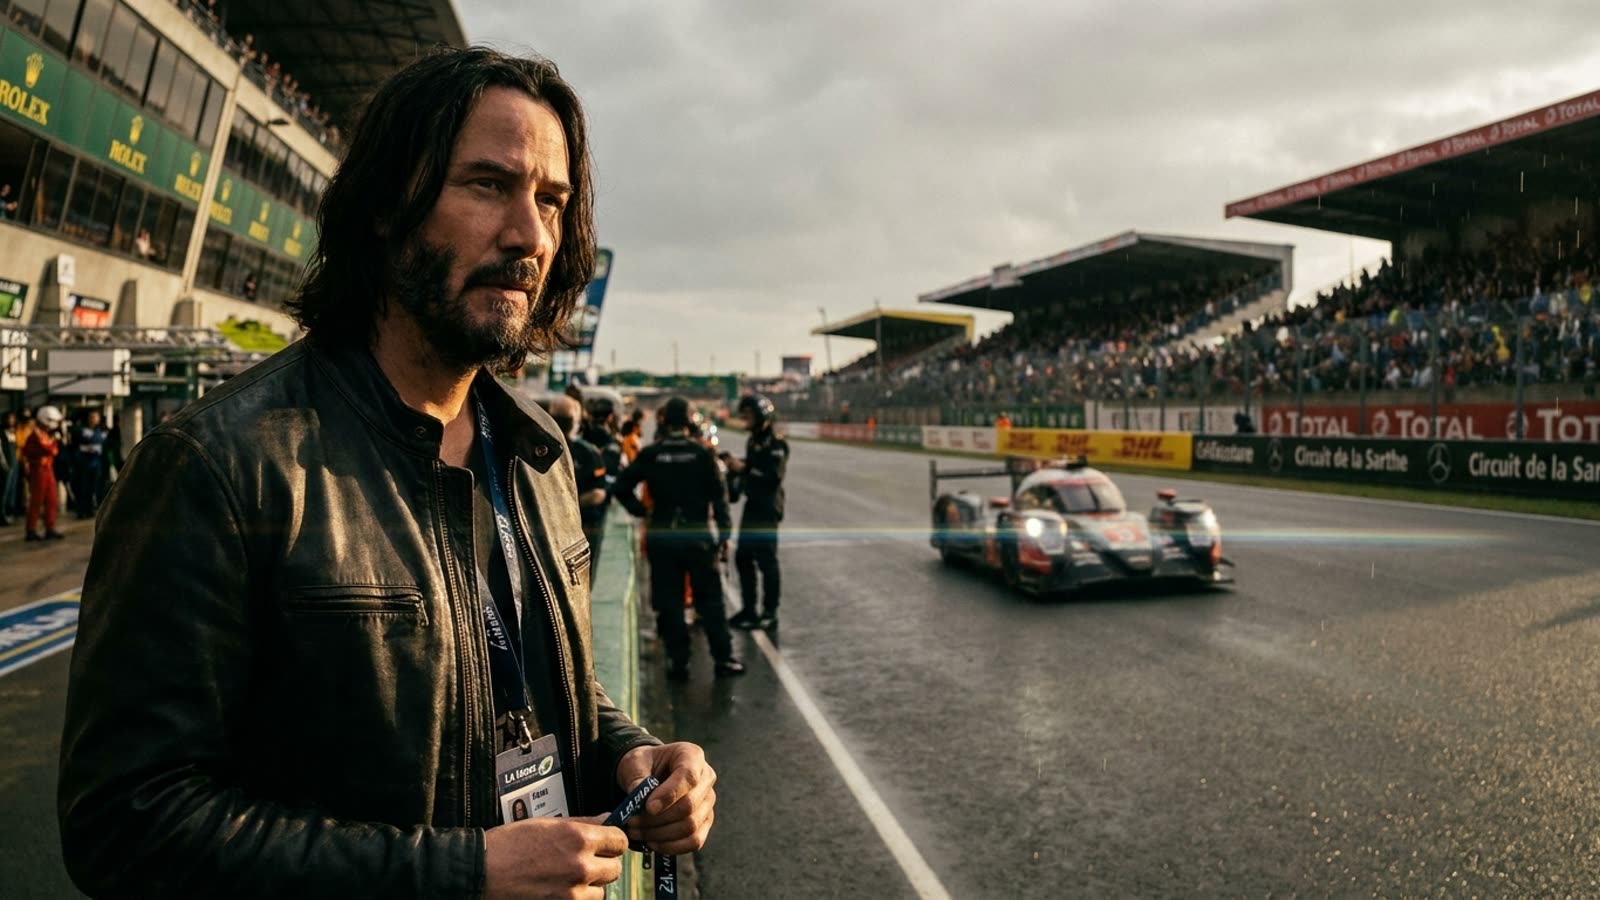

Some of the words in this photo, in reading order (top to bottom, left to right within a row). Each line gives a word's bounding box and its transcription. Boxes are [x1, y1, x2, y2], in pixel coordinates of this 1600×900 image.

[0, 80, 50, 126] ROLEX
[1286, 411, 1355, 437] TOTAL
[1395, 409, 1484, 440] TOTAL
[1120, 436, 1163, 457] DHL
[1294, 445, 1332, 468] Circuit
[1333, 448, 1349, 468] de
[1350, 447, 1363, 469] la
[1365, 448, 1409, 472] Sarthe
[1469, 451, 1521, 478] Circuit
[1525, 453, 1547, 480] de
[1551, 453, 1567, 481] la
